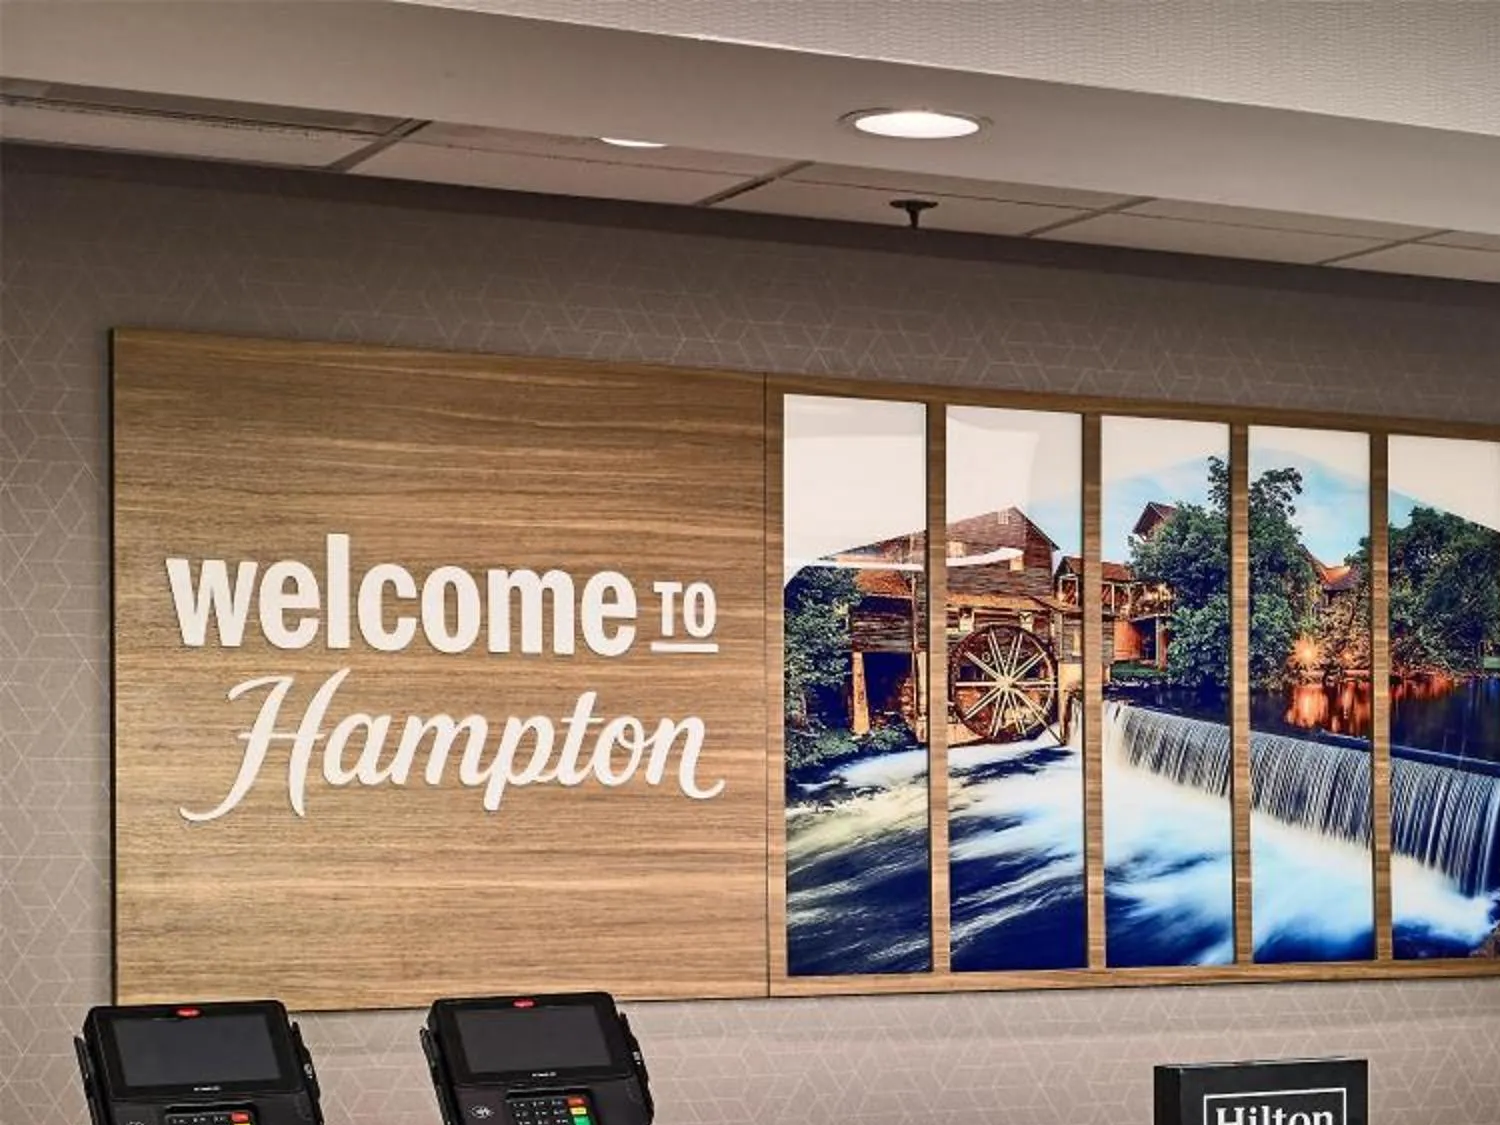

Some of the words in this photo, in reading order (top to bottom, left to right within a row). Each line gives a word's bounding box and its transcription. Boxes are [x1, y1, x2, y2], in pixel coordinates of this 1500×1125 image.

[164, 533, 637, 656] welcome
[652, 581, 718, 640] TO
[179, 667, 725, 821] Hampton
